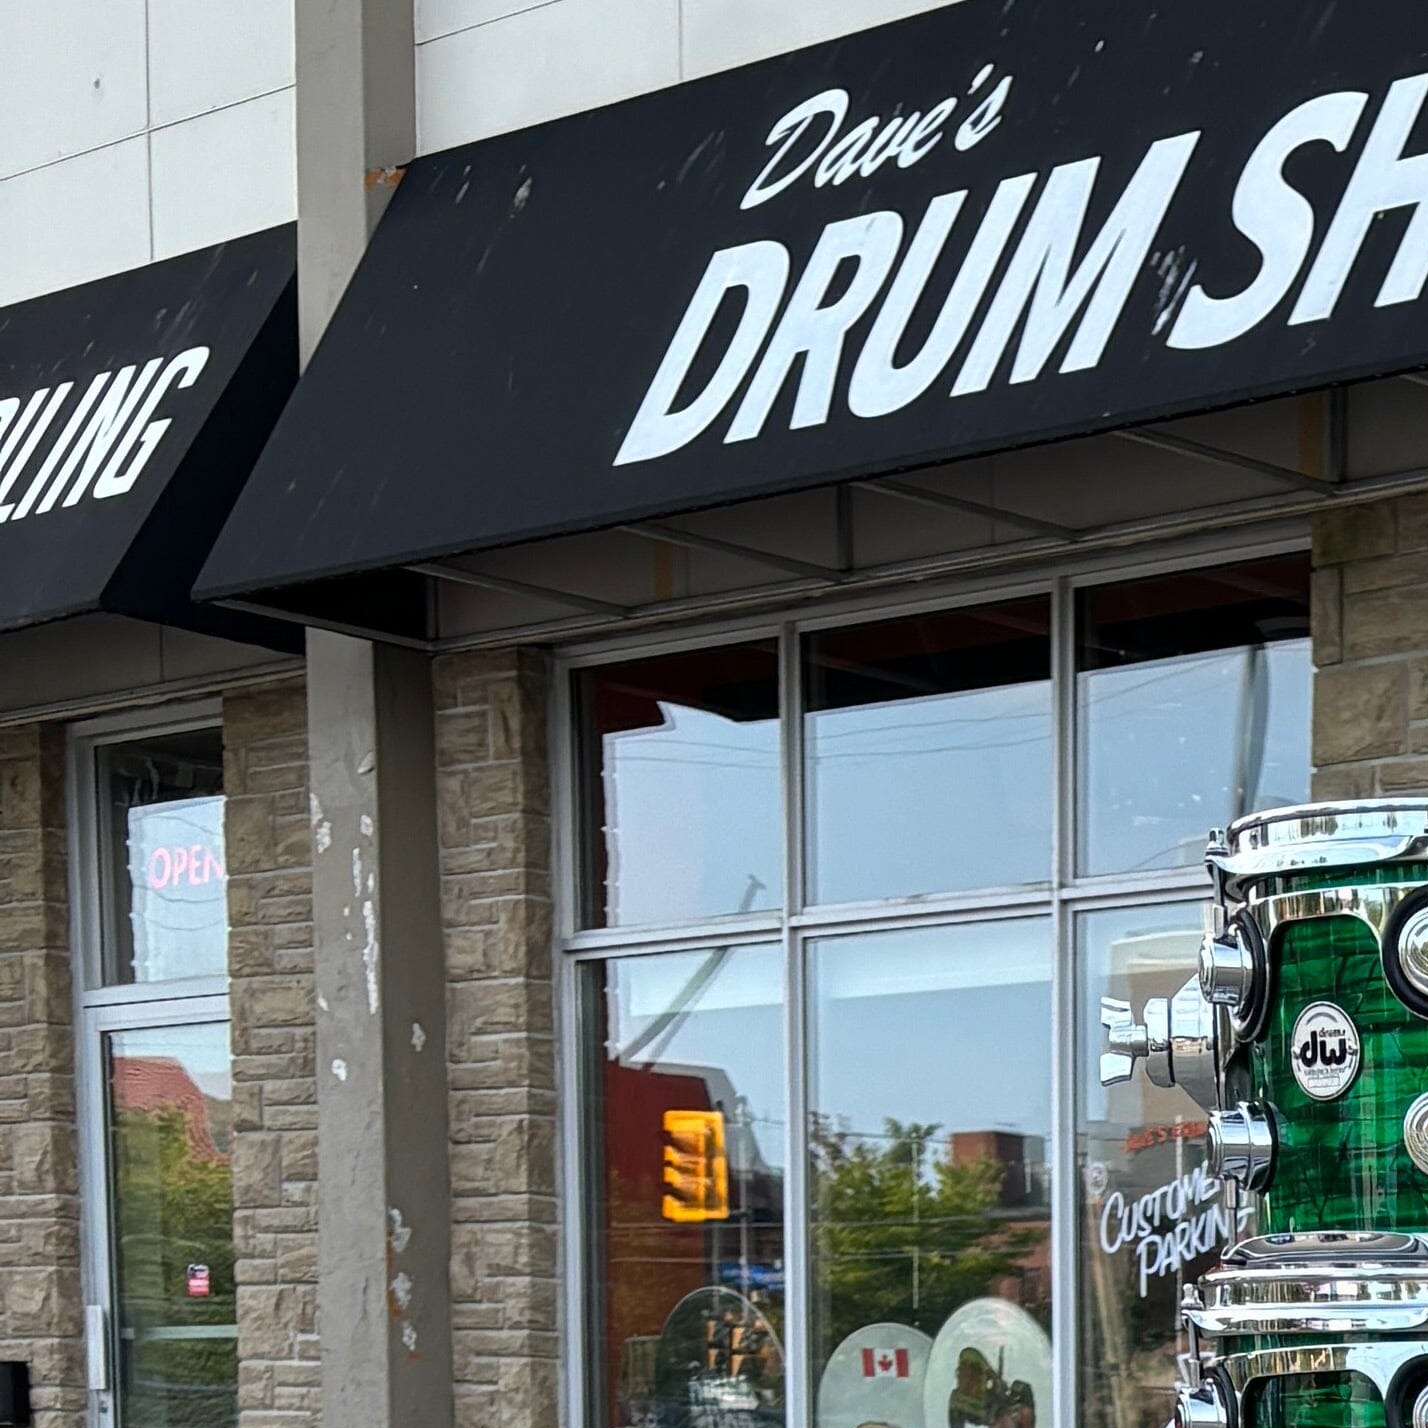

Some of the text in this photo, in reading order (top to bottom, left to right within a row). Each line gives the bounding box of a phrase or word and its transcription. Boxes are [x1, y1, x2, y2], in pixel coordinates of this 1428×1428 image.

[741, 63, 1012, 210] Dave's
[613, 131, 1201, 466] DRUM
[1300, 1030, 1347, 1068] dw
[1101, 1160, 1249, 1254] CUSTOME
